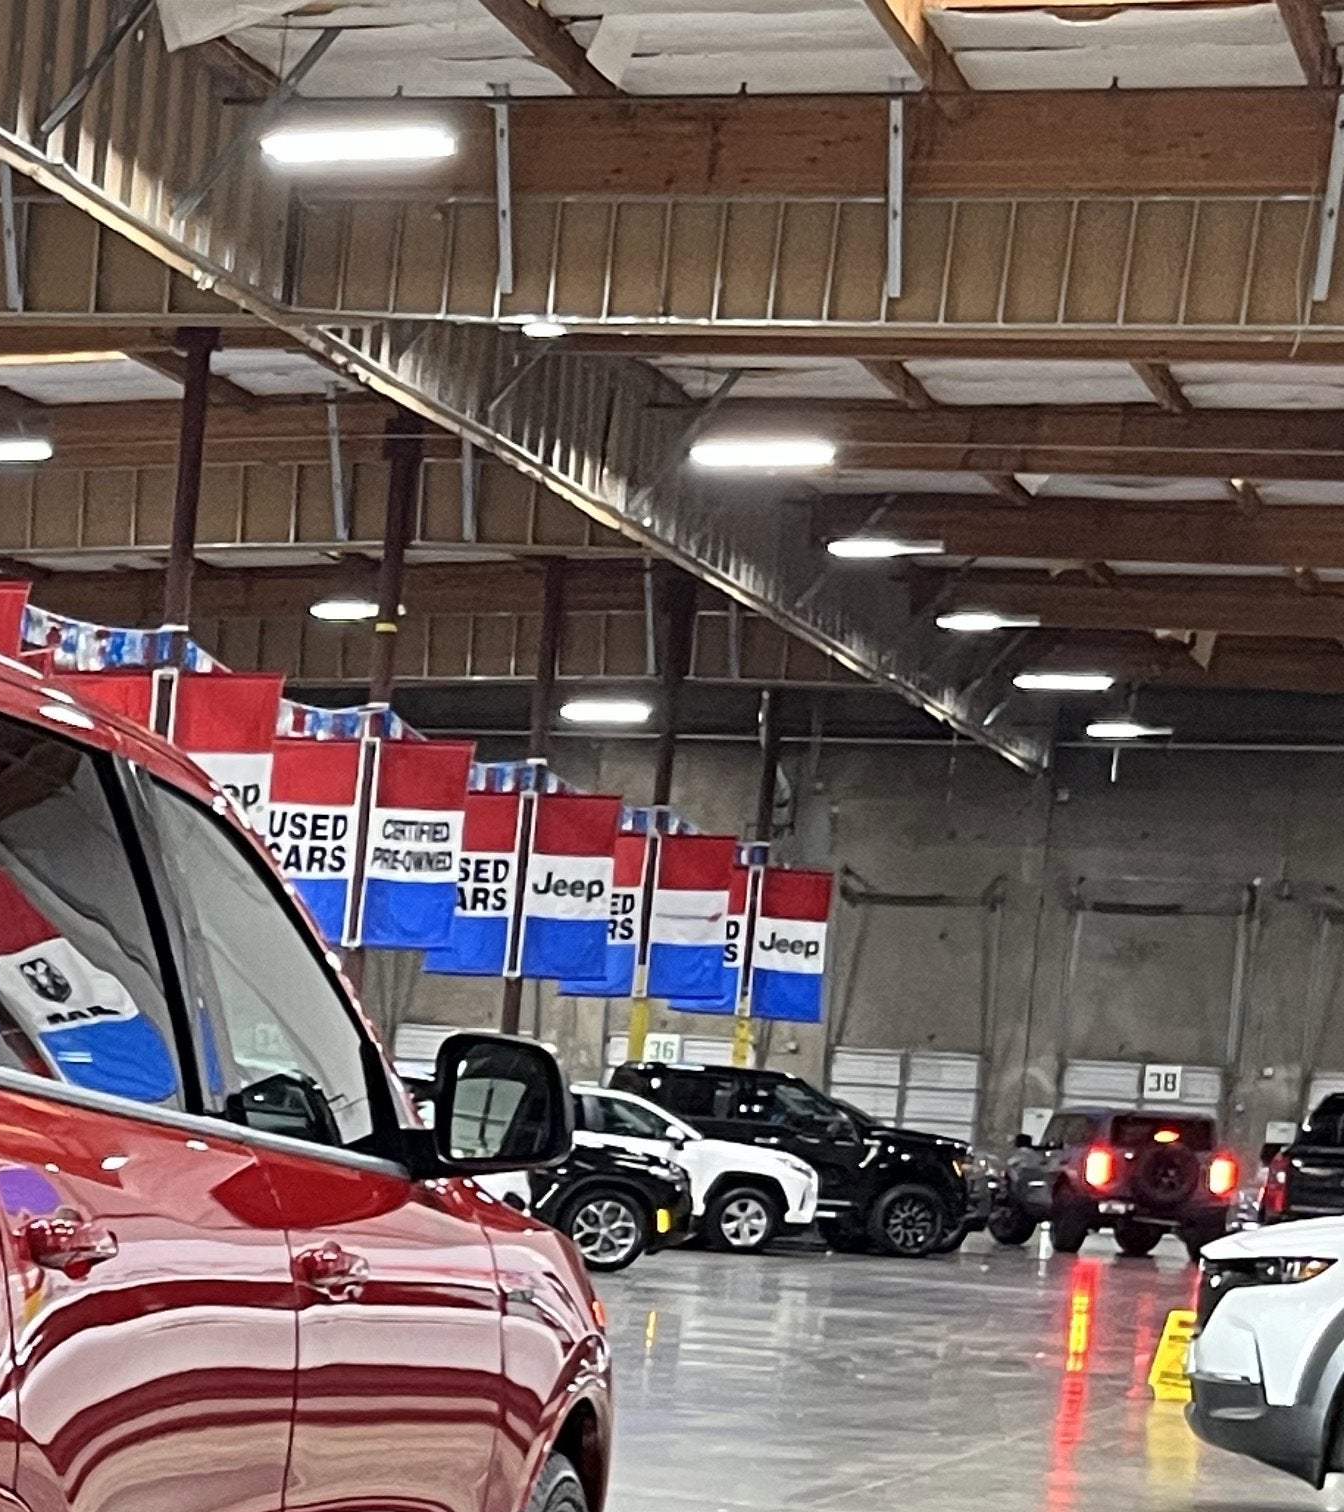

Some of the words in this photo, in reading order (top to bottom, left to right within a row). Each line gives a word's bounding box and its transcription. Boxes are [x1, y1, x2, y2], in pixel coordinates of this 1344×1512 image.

[268, 811, 348, 841] USED
[382, 819, 450, 843] CERTIFIED
[371, 846, 453, 872] PRE-OWNED
[458, 857, 510, 883] SED
[456, 886, 507, 911] ARS
[531, 871, 605, 902] Jeep
[610, 893, 636, 916] ED
[759, 932, 821, 959] Jeep
[648, 1039, 676, 1061] 36
[1147, 1072, 1178, 1093] 38
